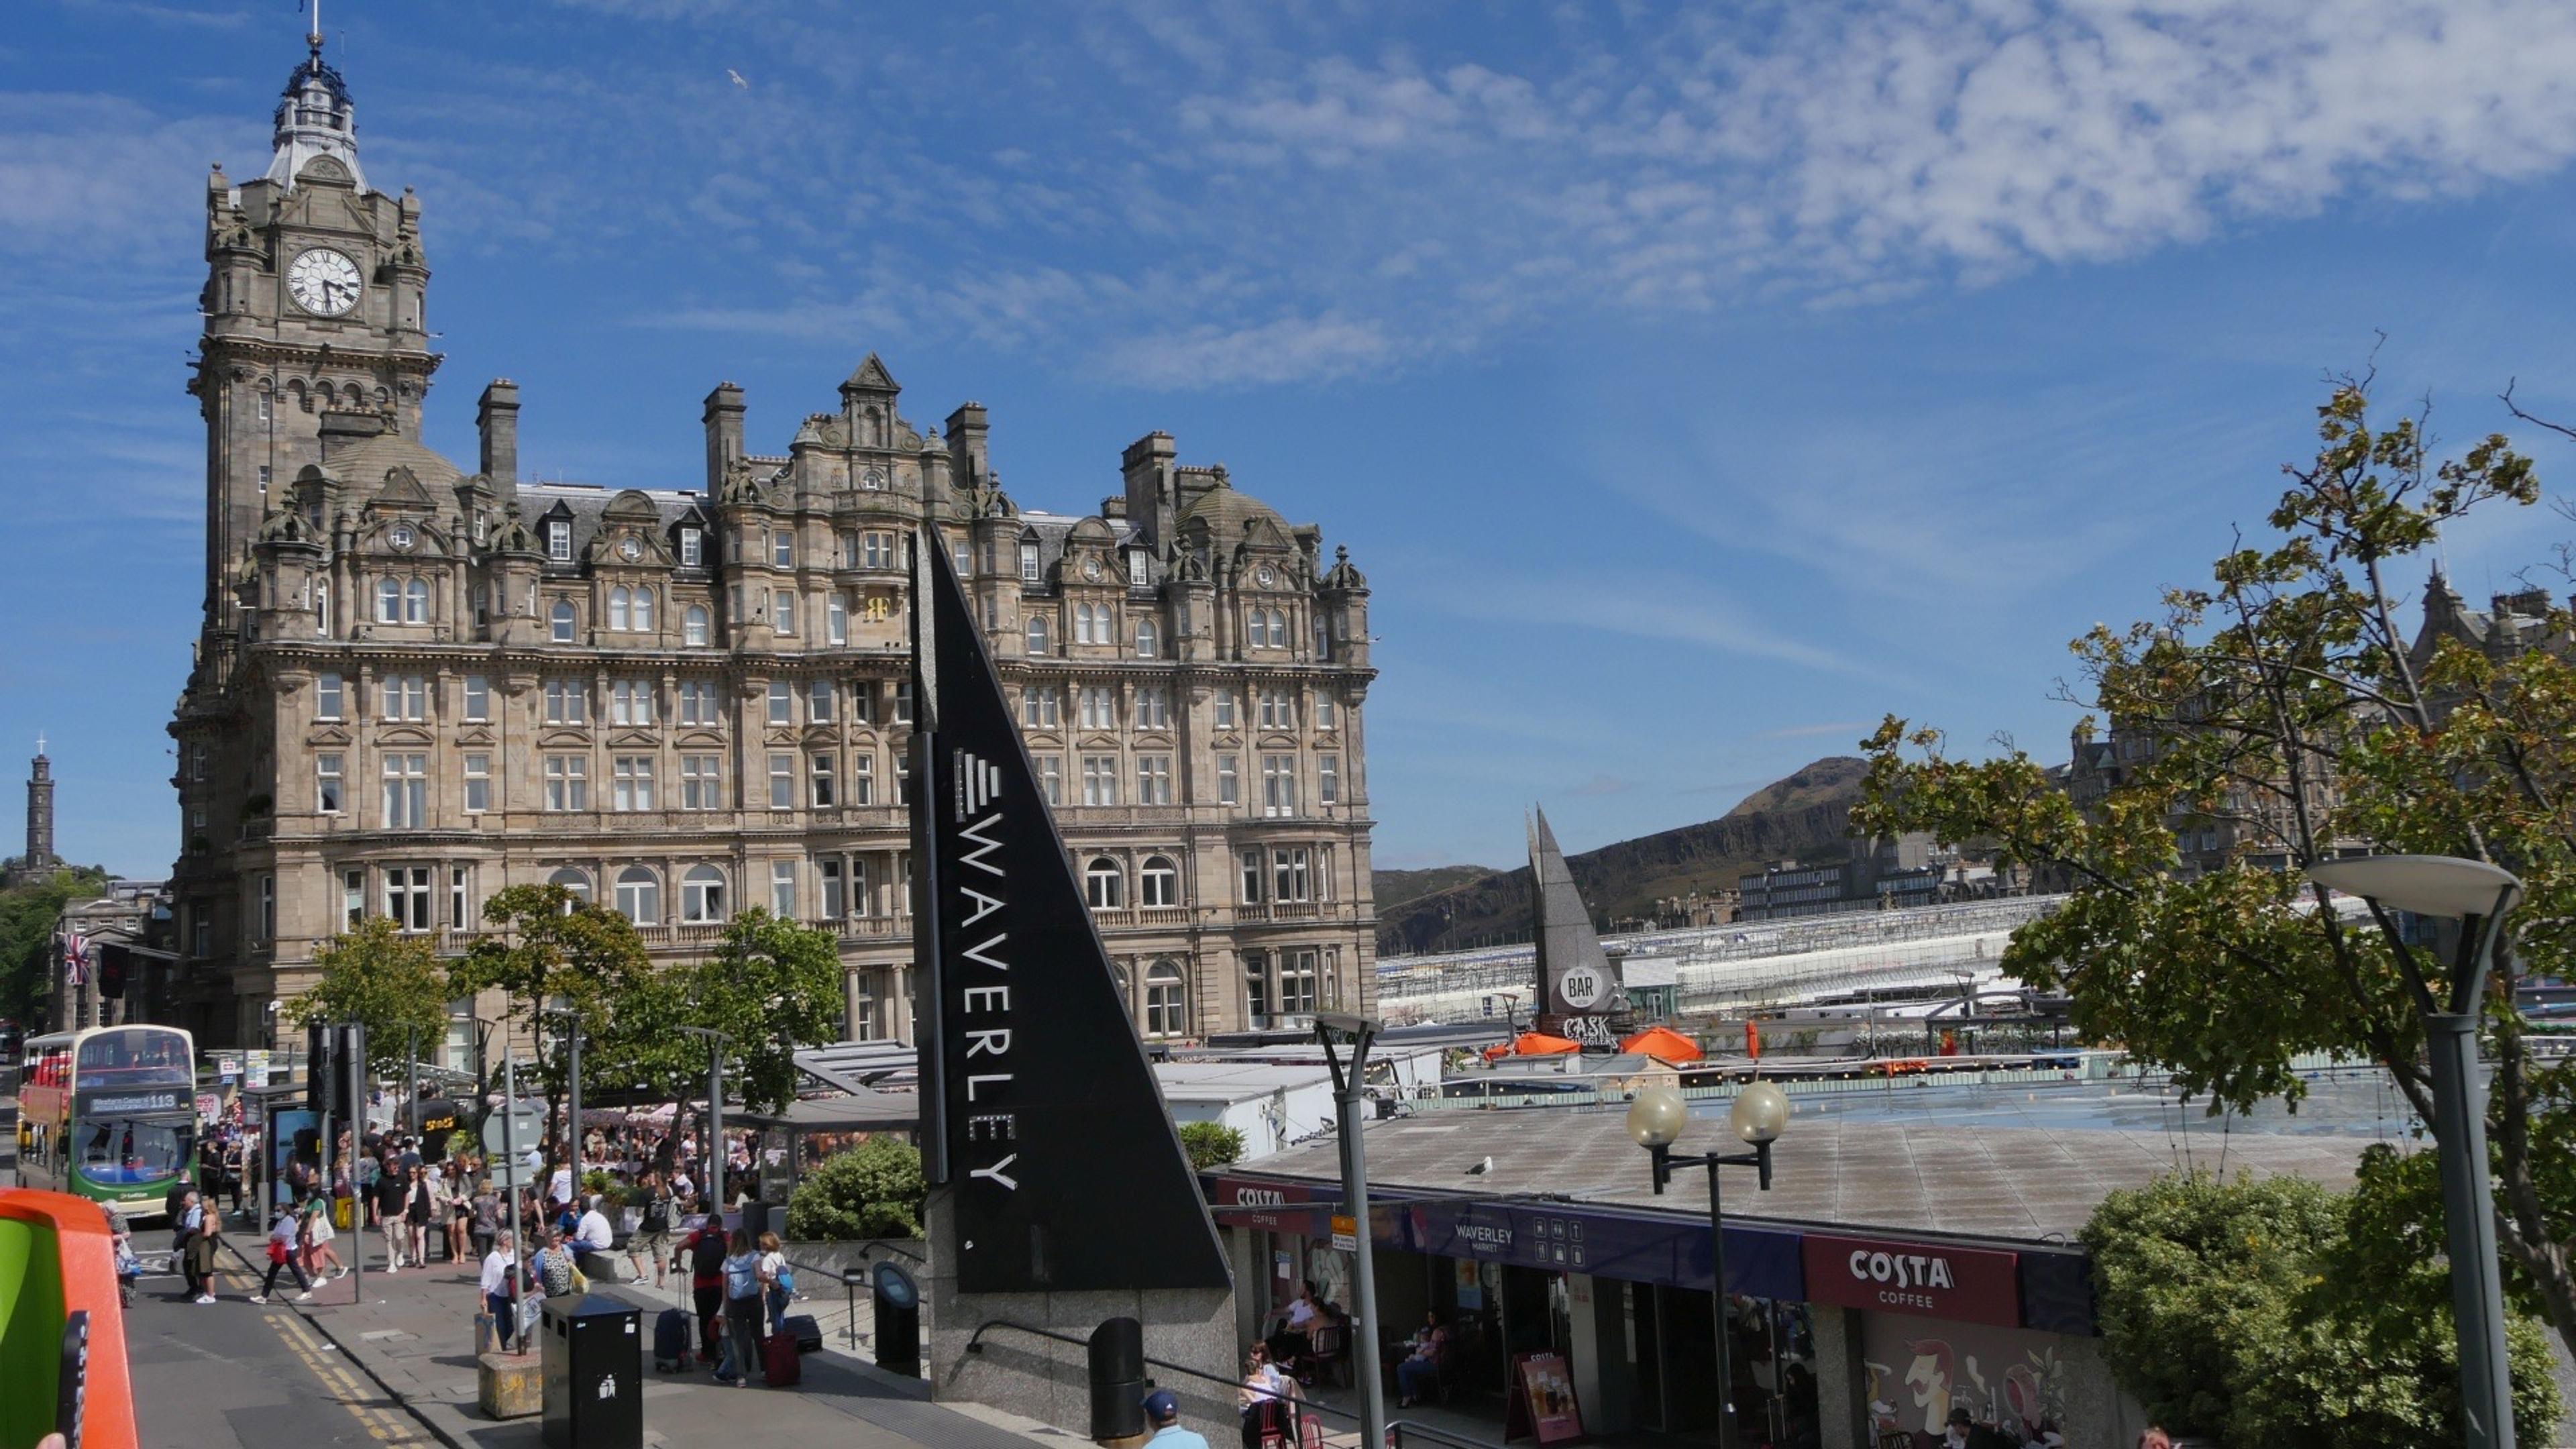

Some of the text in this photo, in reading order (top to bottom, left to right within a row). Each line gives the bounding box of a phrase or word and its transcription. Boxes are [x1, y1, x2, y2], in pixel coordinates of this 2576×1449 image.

[1568, 977, 1593, 998] BAR
[958, 812, 1018, 1191] WAVERLEY
[1563, 1016, 1609, 1038] CASK
[150, 1094, 175, 1108] 113
[1237, 1187, 1285, 1207] COSTA
[1252, 1214, 1277, 1226] COFFEE
[1456, 1224, 1512, 1244] WAVERLEY
[1472, 1242, 1497, 1252] MARKET
[1849, 1250, 1955, 1289] COSTA
[1879, 1291, 1933, 1308] COFFEE
[1530, 1352, 1555, 1362] COSTA
